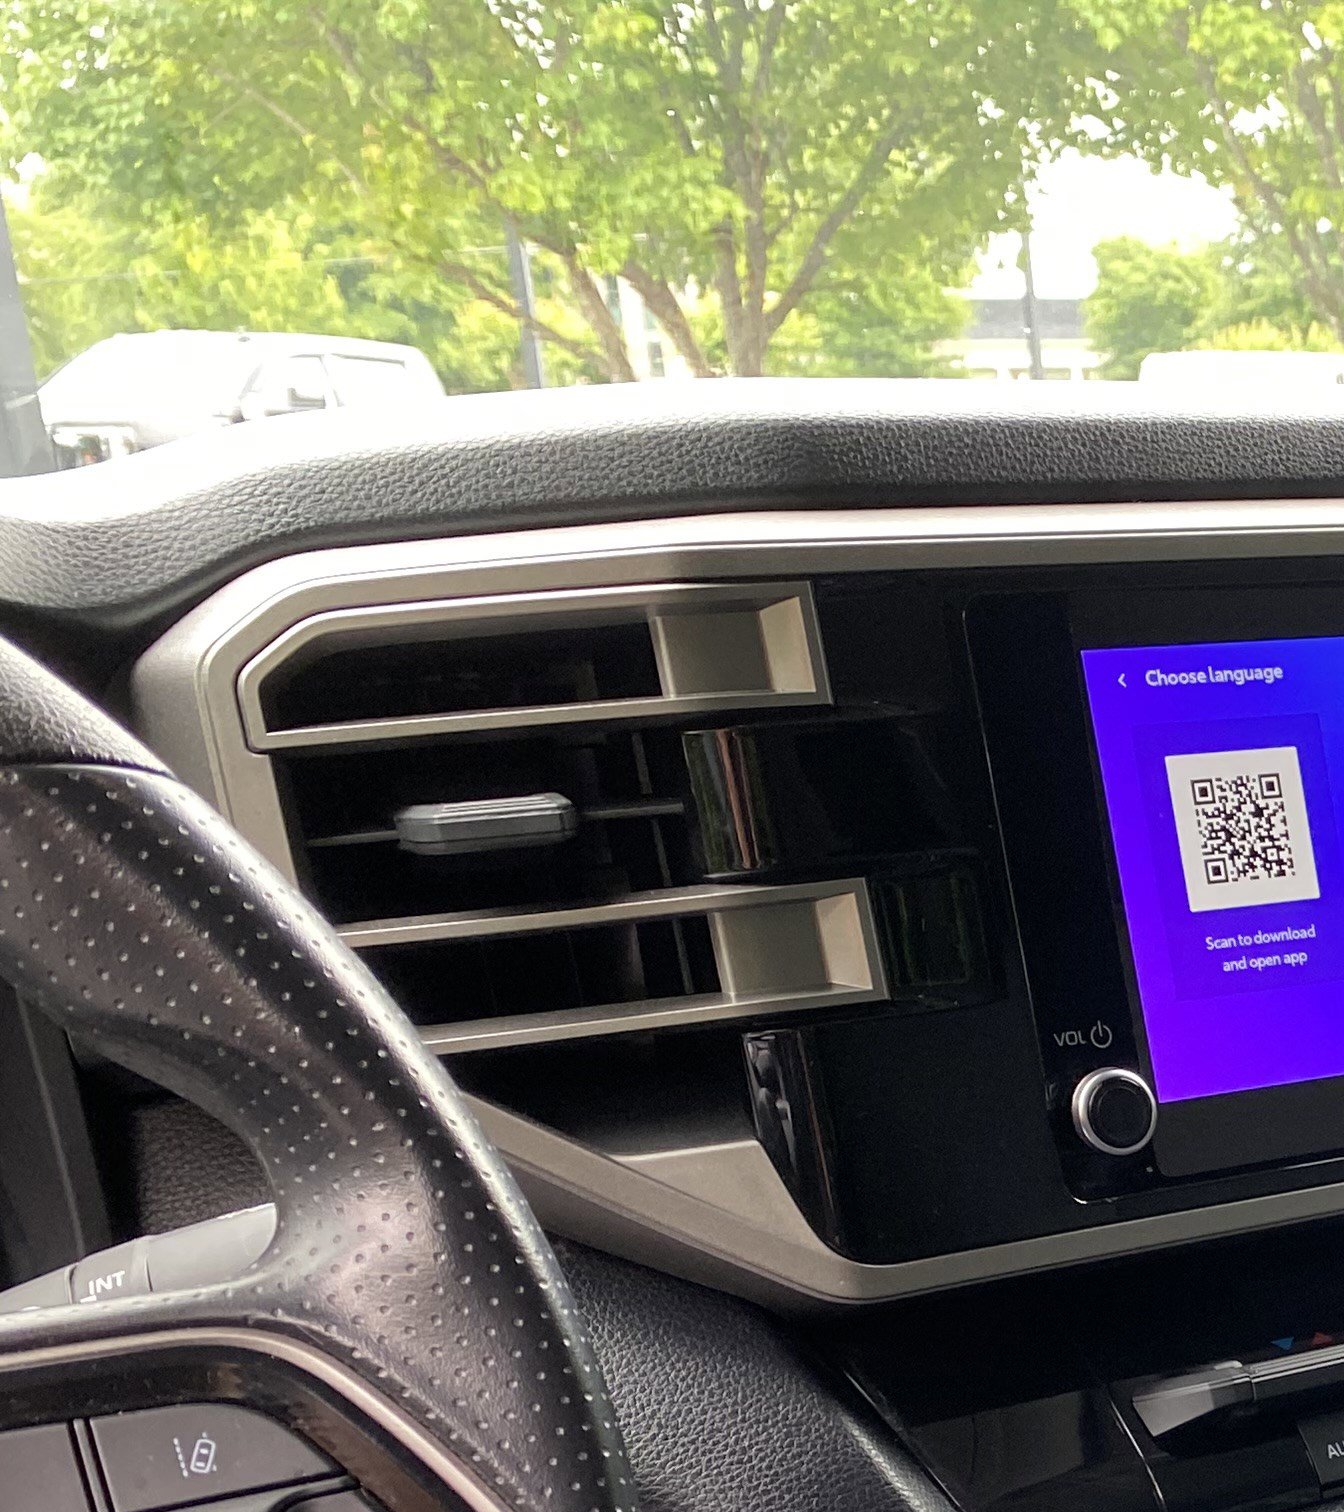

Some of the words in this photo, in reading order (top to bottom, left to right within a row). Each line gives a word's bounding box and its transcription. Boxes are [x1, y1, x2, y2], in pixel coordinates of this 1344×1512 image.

[1145, 668, 1207, 687] Choose
[1208, 666, 1283, 685] language
[1205, 936, 1237, 951] Scan
[1237, 933, 1253, 946] to
[1253, 923, 1317, 945] download
[1223, 955, 1248, 972] and
[1249, 954, 1282, 972] open
[1283, 952, 1308, 967] app
[1053, 1030, 1087, 1046] VOL
[88, 1270, 126, 1296] INT
